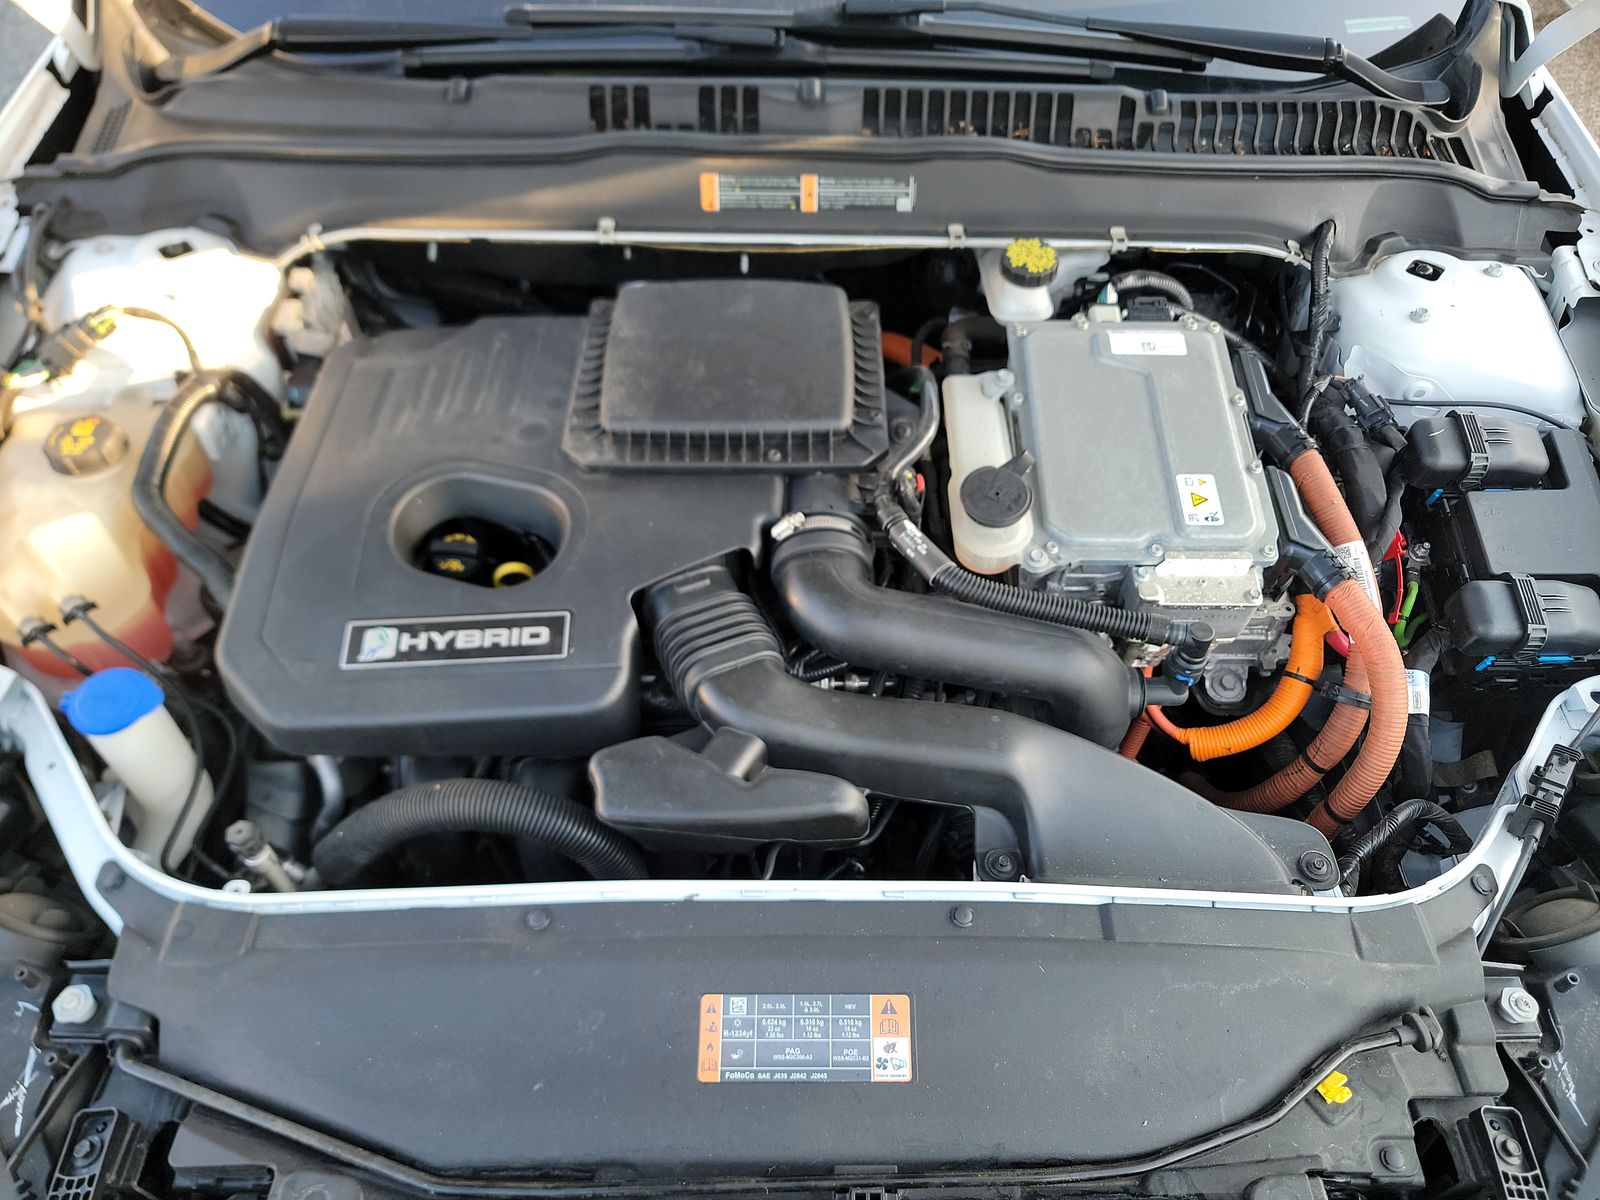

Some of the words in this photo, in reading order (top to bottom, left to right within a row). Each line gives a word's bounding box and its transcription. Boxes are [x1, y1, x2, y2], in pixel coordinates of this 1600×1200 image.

[399, 625, 551, 652] HYBRID
[779, 1018, 787, 1027] kg
[816, 1018, 825, 1027] kg
[855, 1018, 863, 1027] kg
[723, 1029, 753, 1038] R-1234yf
[843, 1048, 859, 1056] POE
[725, 1071, 755, 1079] FoMoCo
